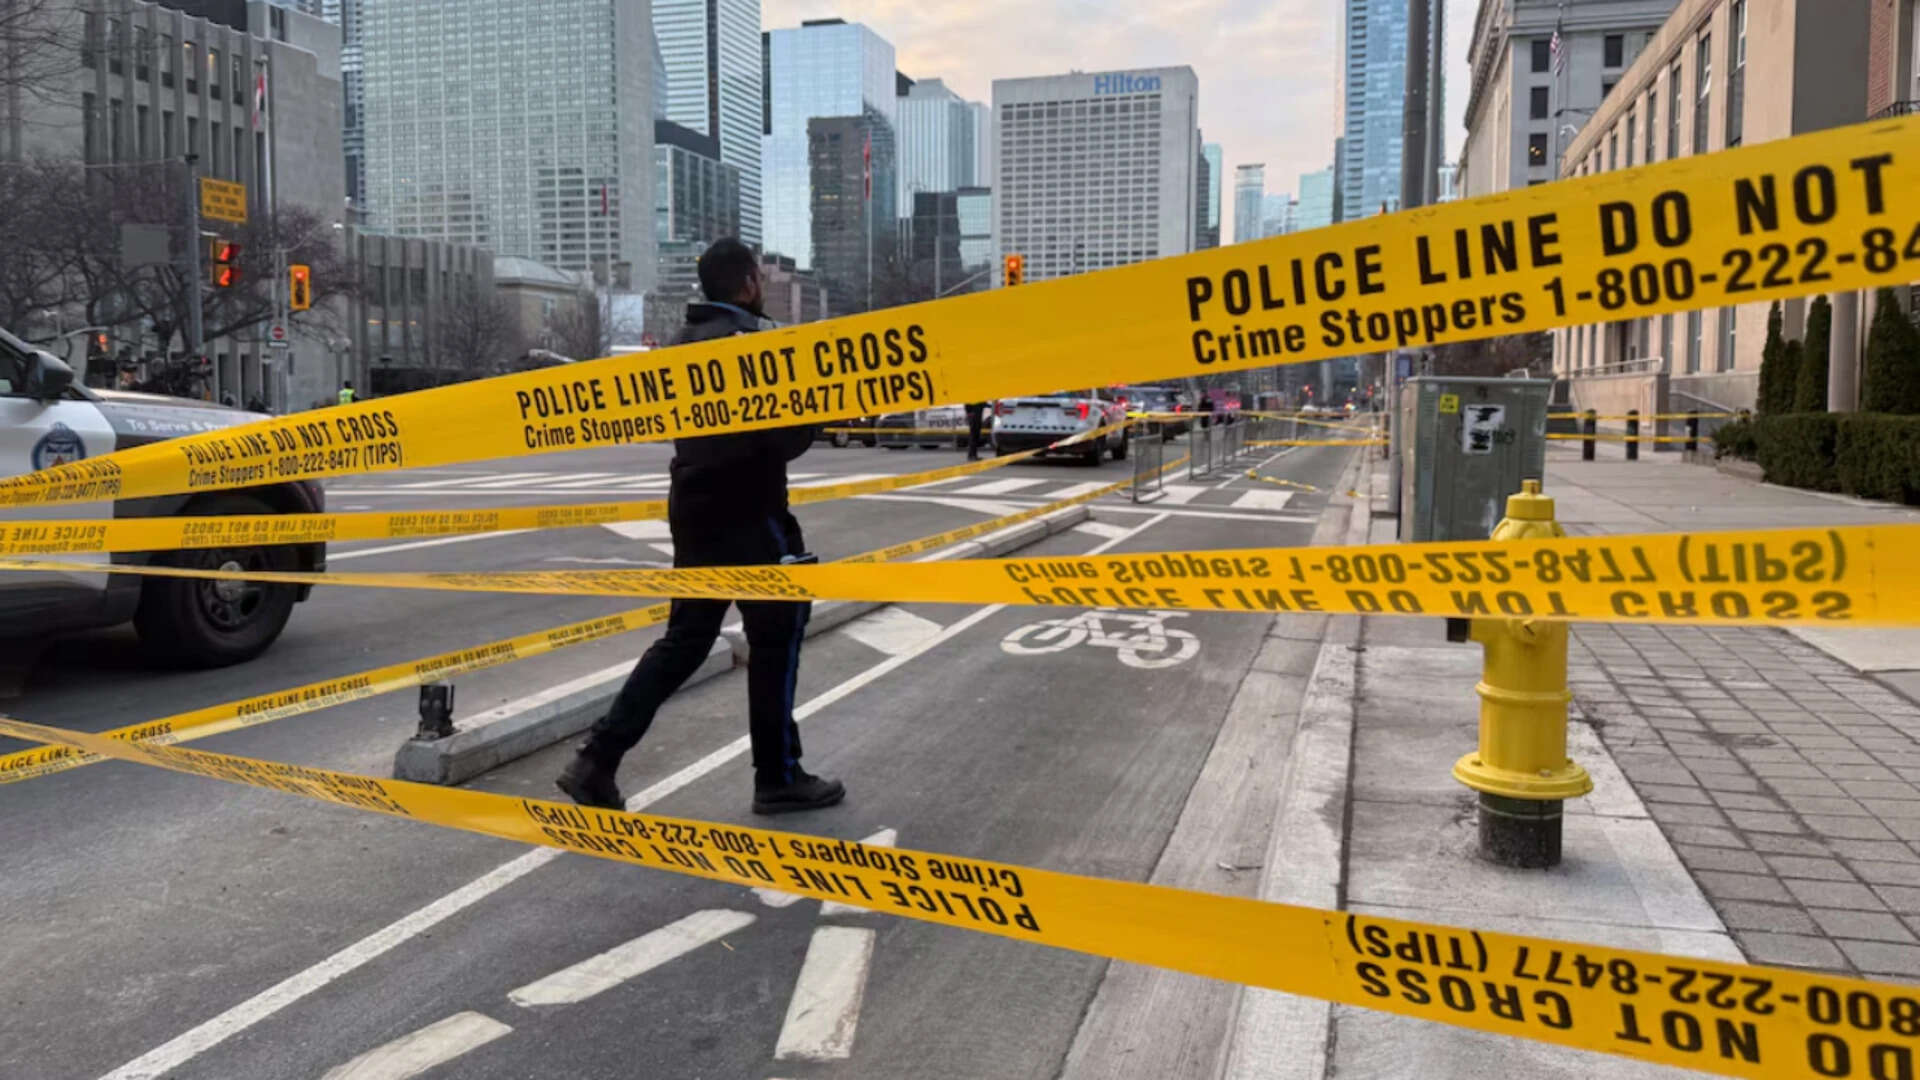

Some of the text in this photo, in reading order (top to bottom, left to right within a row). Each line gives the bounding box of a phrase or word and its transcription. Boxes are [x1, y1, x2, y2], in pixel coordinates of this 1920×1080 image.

[1094, 73, 1161, 95] Hilton
[1186, 153, 1893, 322] POLICE LINE DO NOT
[1191, 323, 1306, 366] Crime
[1320, 291, 1526, 347] Stoppers
[517, 324, 929, 419] POLICE LINE DO NOT CROSS
[126, 419, 147, 432] To
[181, 410, 399, 466] POLICE LINE DO NOT CROSS
[524, 369, 935, 449] Crime Stoppers 1-800-222-8477 (TIPS)
[188, 440, 404, 488] Crime Stoppers 1-800-222-8477 (TIPS)
[237, 676, 370, 716] POLICE LINE DO NOT CROSS
[131, 722, 172, 742] CROSS
[523, 800, 1024, 898] Crime Stoppers 1-800-222-8477 (TIPS)
[542, 827, 1041, 932] POLICE LINE DO NOT CROSS
[1346, 914, 1488, 973] (TIPS)
[1356, 961, 1914, 1080] DO NOT CROSS
